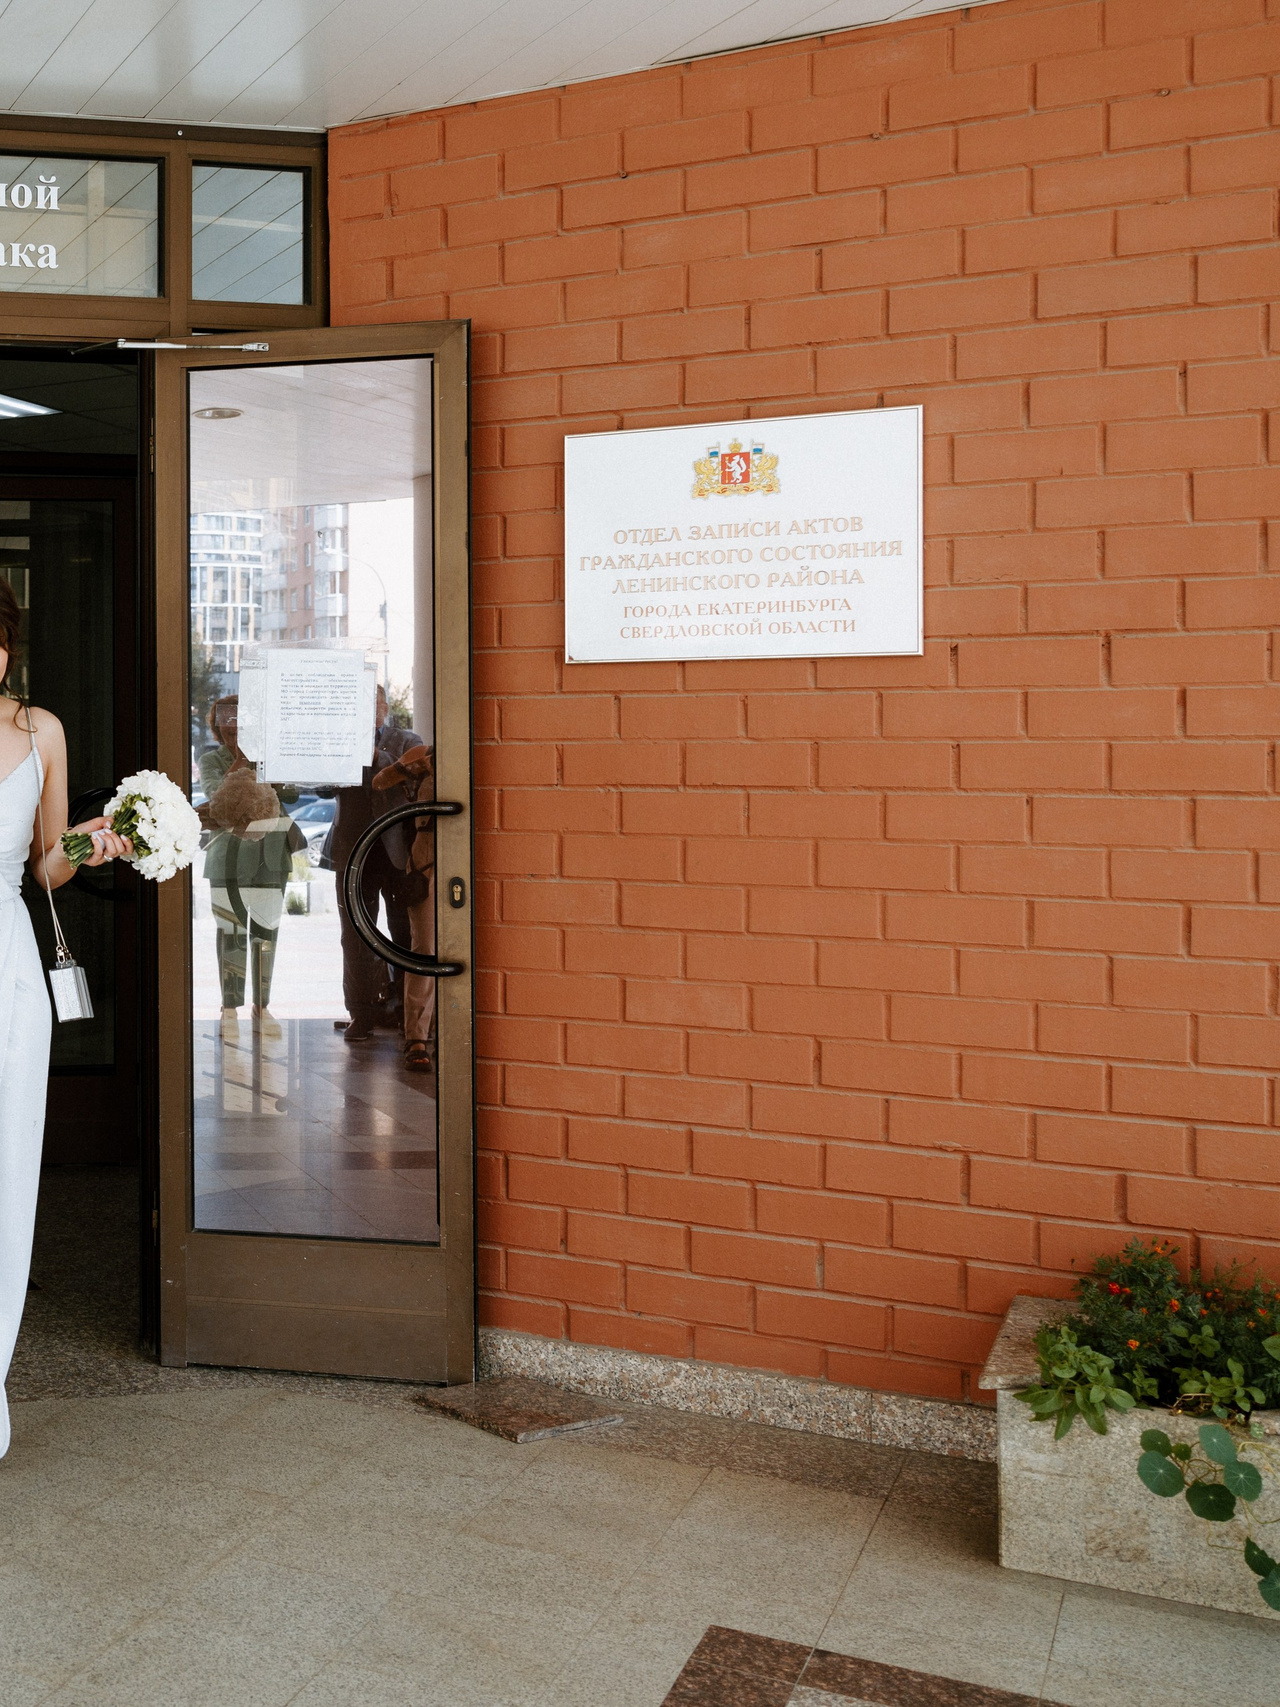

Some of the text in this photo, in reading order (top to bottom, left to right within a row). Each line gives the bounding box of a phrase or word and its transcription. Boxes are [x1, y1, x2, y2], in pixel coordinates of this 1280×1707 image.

[612, 516, 864, 546] ОТДЕЛ ЗАПИСИ АКТОВ
[579, 540, 903, 571] ГРАЖДАНСКОГО СОСТОЯНИЯ
[611, 565, 865, 594] ЛЕНИНСКОГО РАЙОНА
[623, 598, 853, 619] ГОРОДА ЕКАТЕРИНБУРГА
[620, 617, 856, 641] СВЕРДЛОВСКОЙ ОБЛАСТИ
